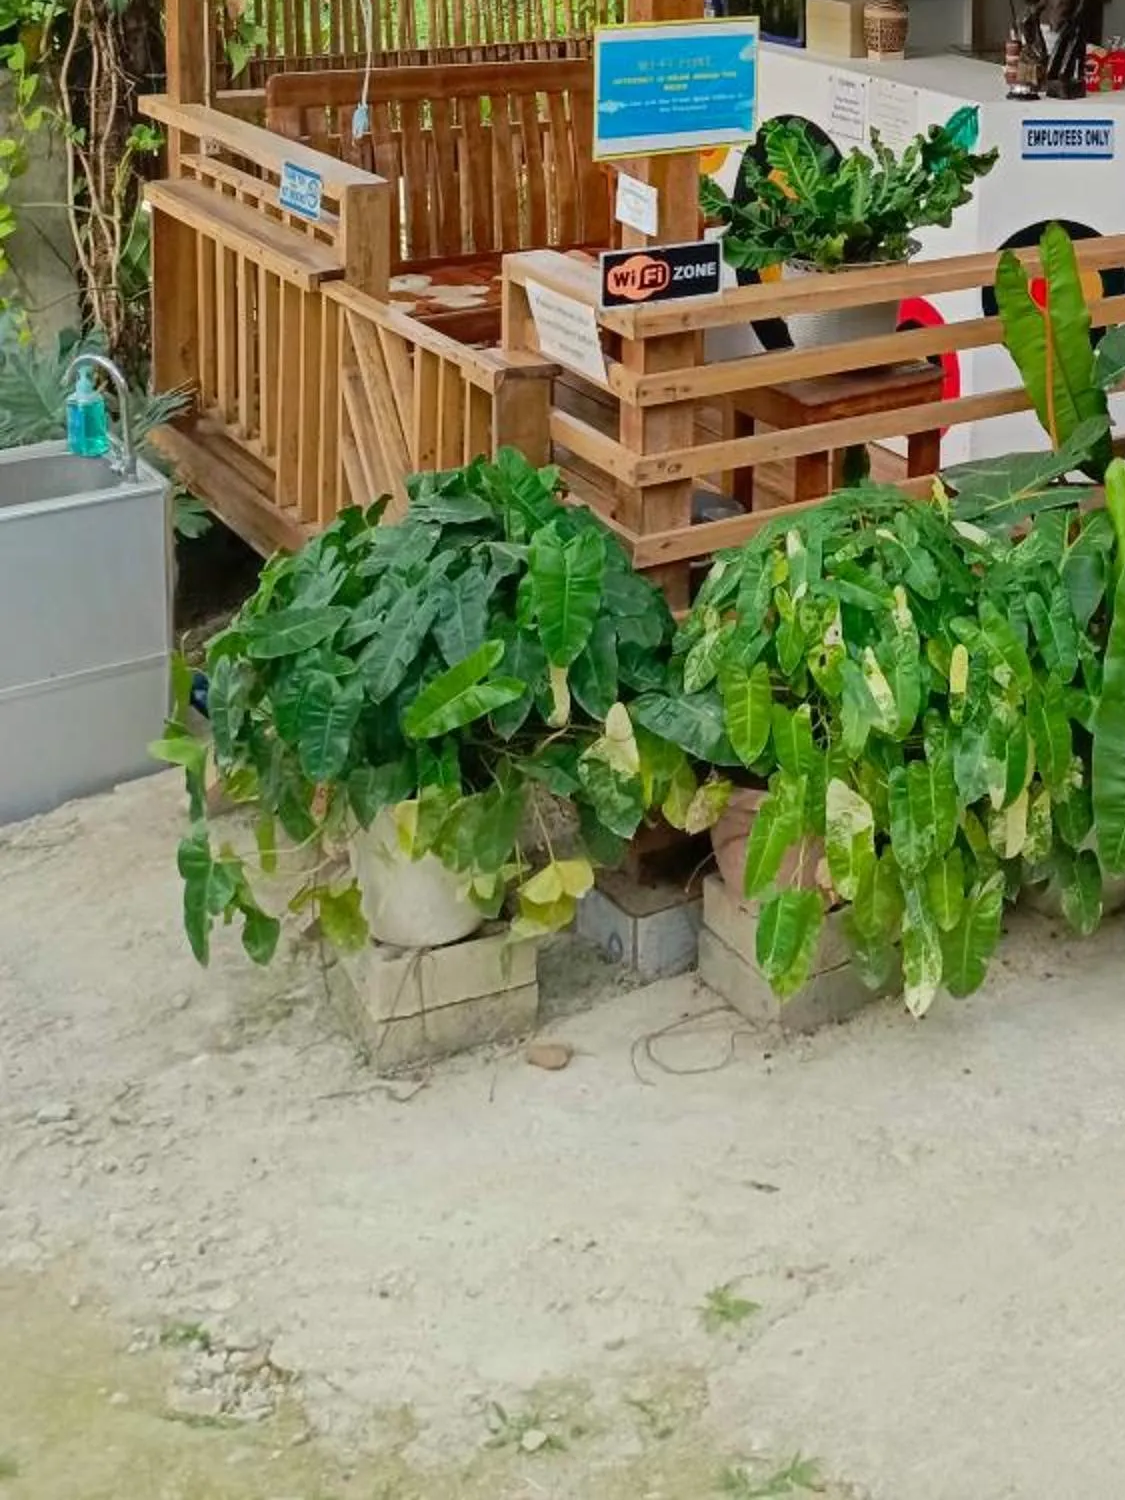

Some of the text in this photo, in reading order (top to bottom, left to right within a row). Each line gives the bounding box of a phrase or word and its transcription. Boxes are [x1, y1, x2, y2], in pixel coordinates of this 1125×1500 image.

[1027, 129, 1111, 147] EMPLOYEES ONLY
[672, 261, 717, 281] ZONE
